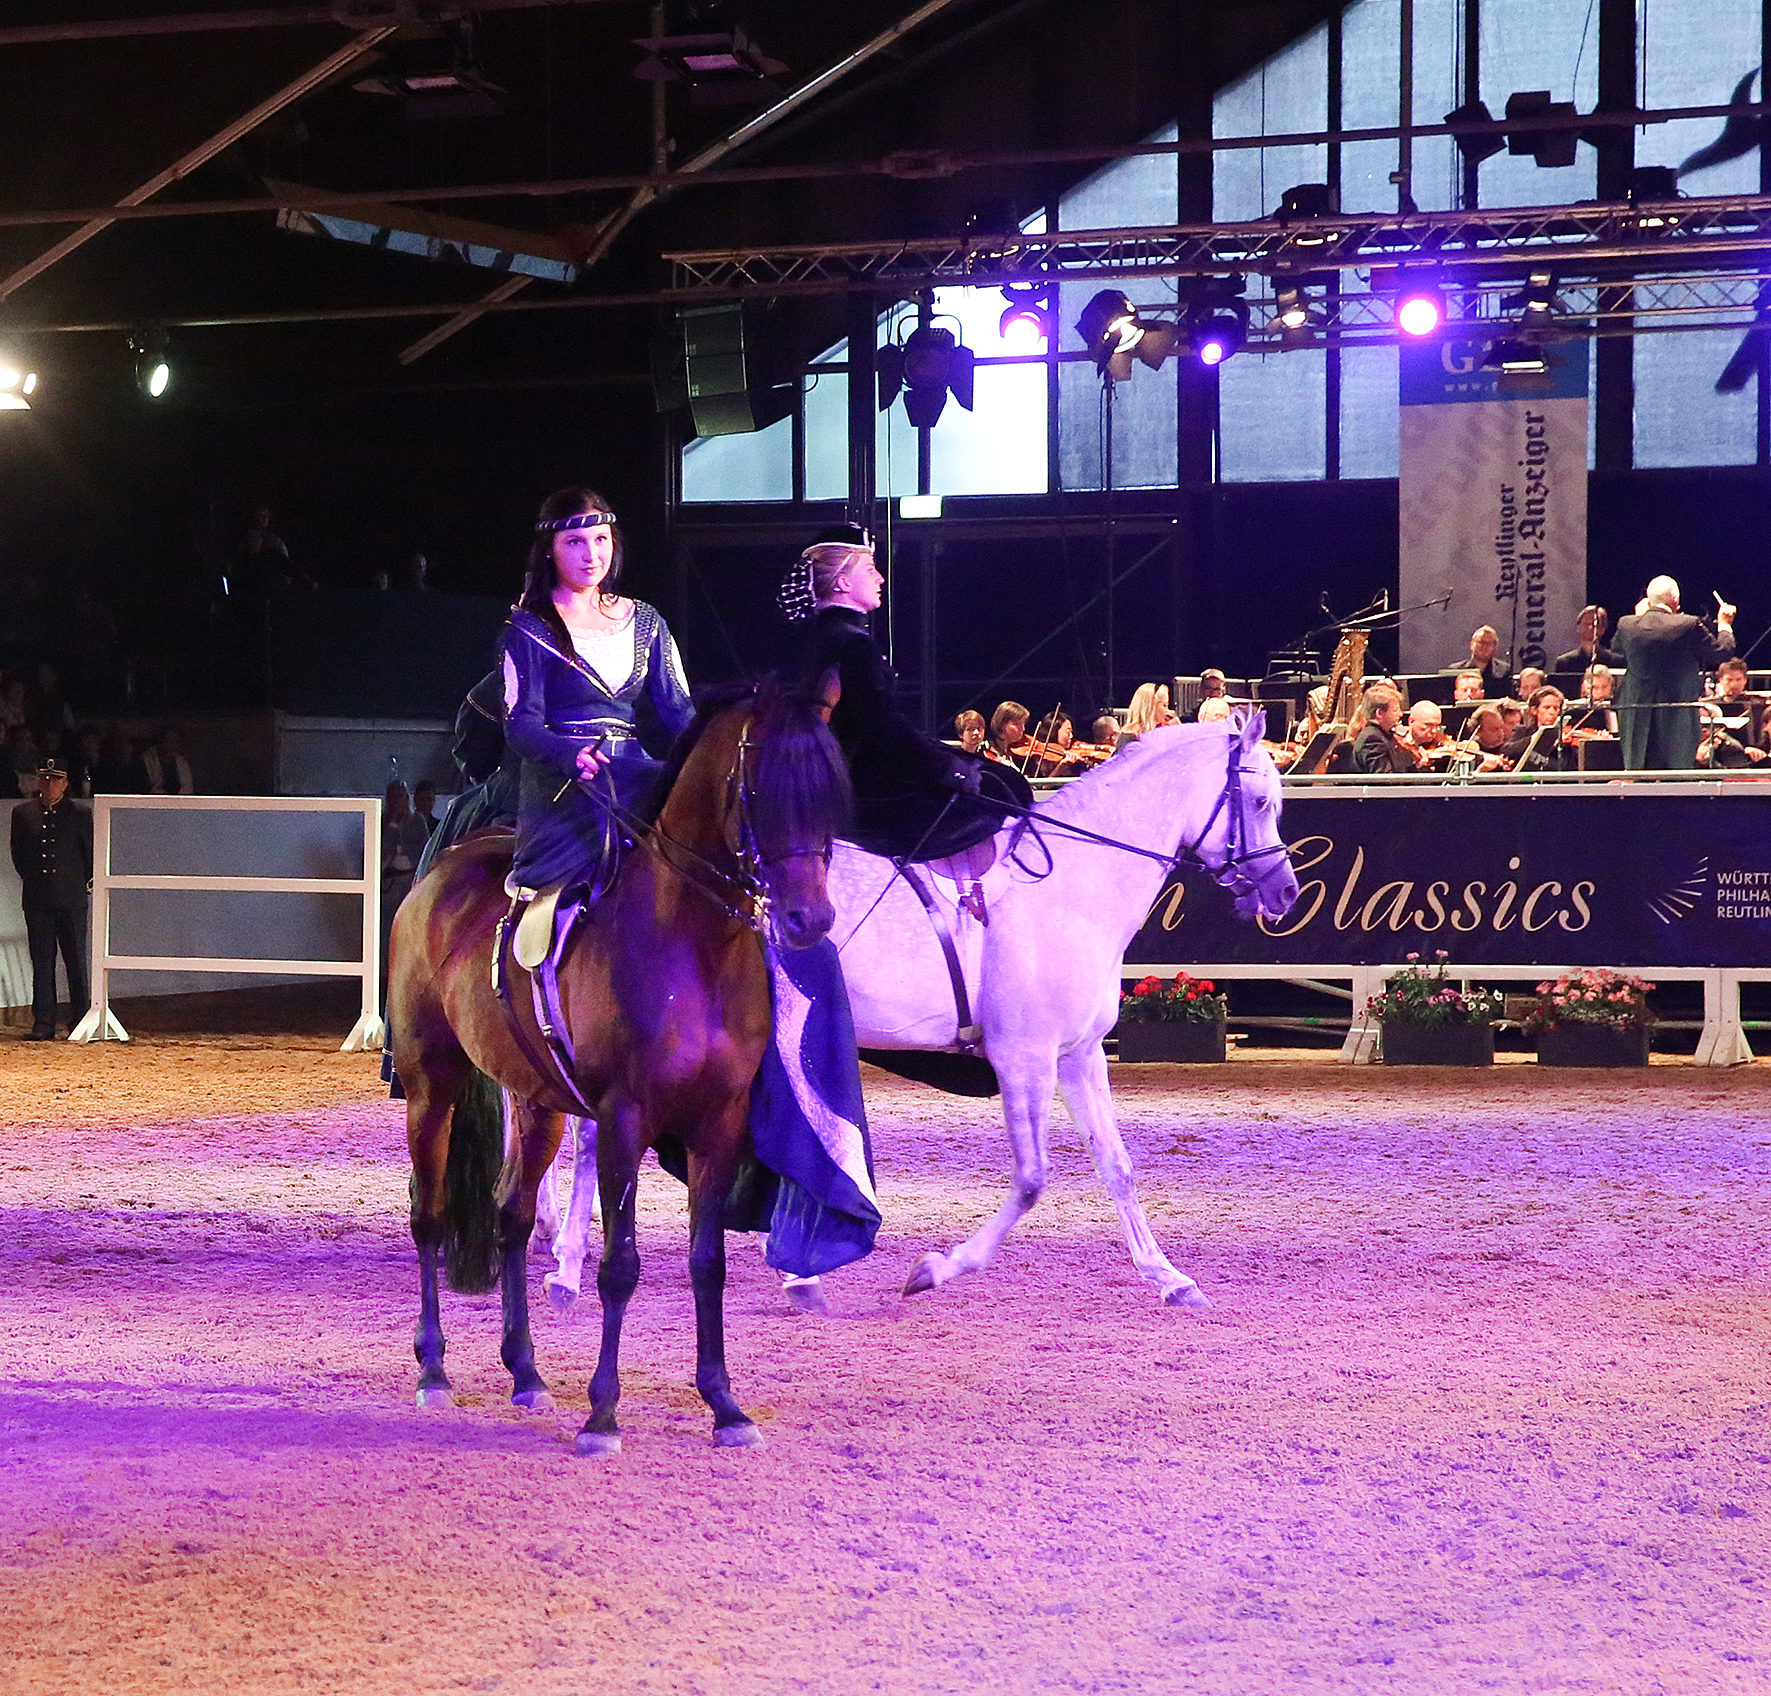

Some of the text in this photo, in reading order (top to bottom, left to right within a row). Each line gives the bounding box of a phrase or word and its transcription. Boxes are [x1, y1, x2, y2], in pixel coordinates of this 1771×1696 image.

[1495, 483, 1518, 602] Reutlinger
[1518, 410, 1550, 669] General-Anzeiger
[1255, 836, 1596, 937] Classics
[1716, 870, 1771, 885] WÜRTT
